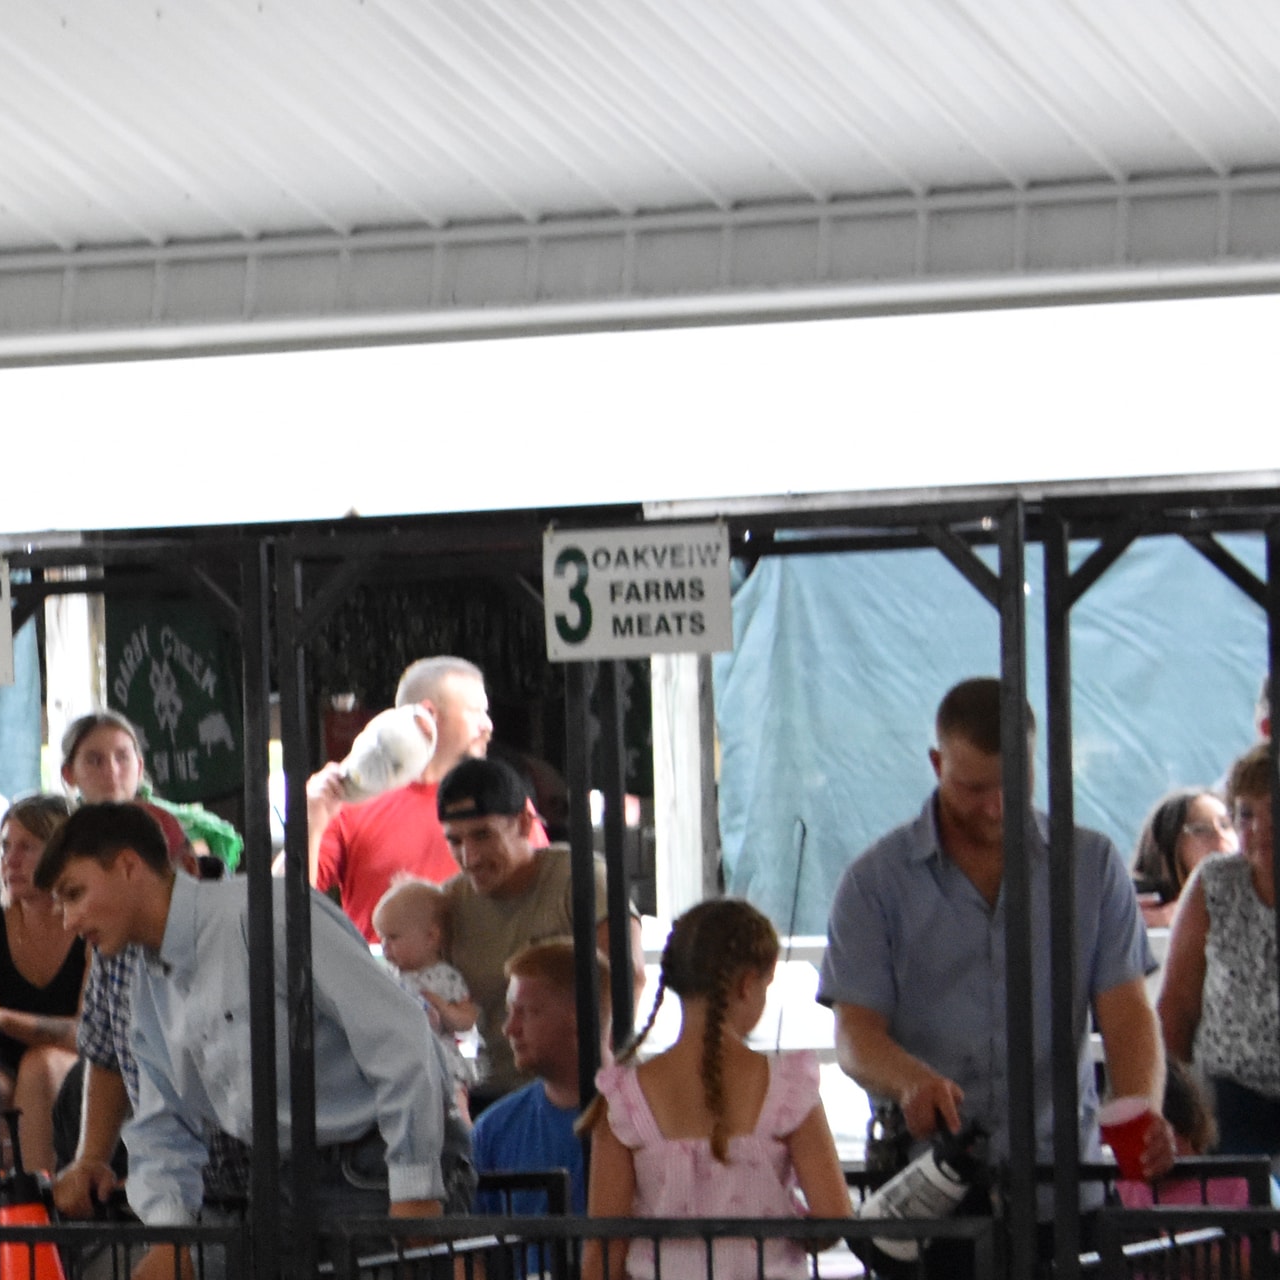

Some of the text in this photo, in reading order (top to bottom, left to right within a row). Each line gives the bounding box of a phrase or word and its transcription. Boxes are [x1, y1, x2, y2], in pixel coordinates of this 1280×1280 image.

[553, 545, 593, 646] 3
[609, 578, 705, 603] FARMS
[612, 611, 706, 638] MEATS
